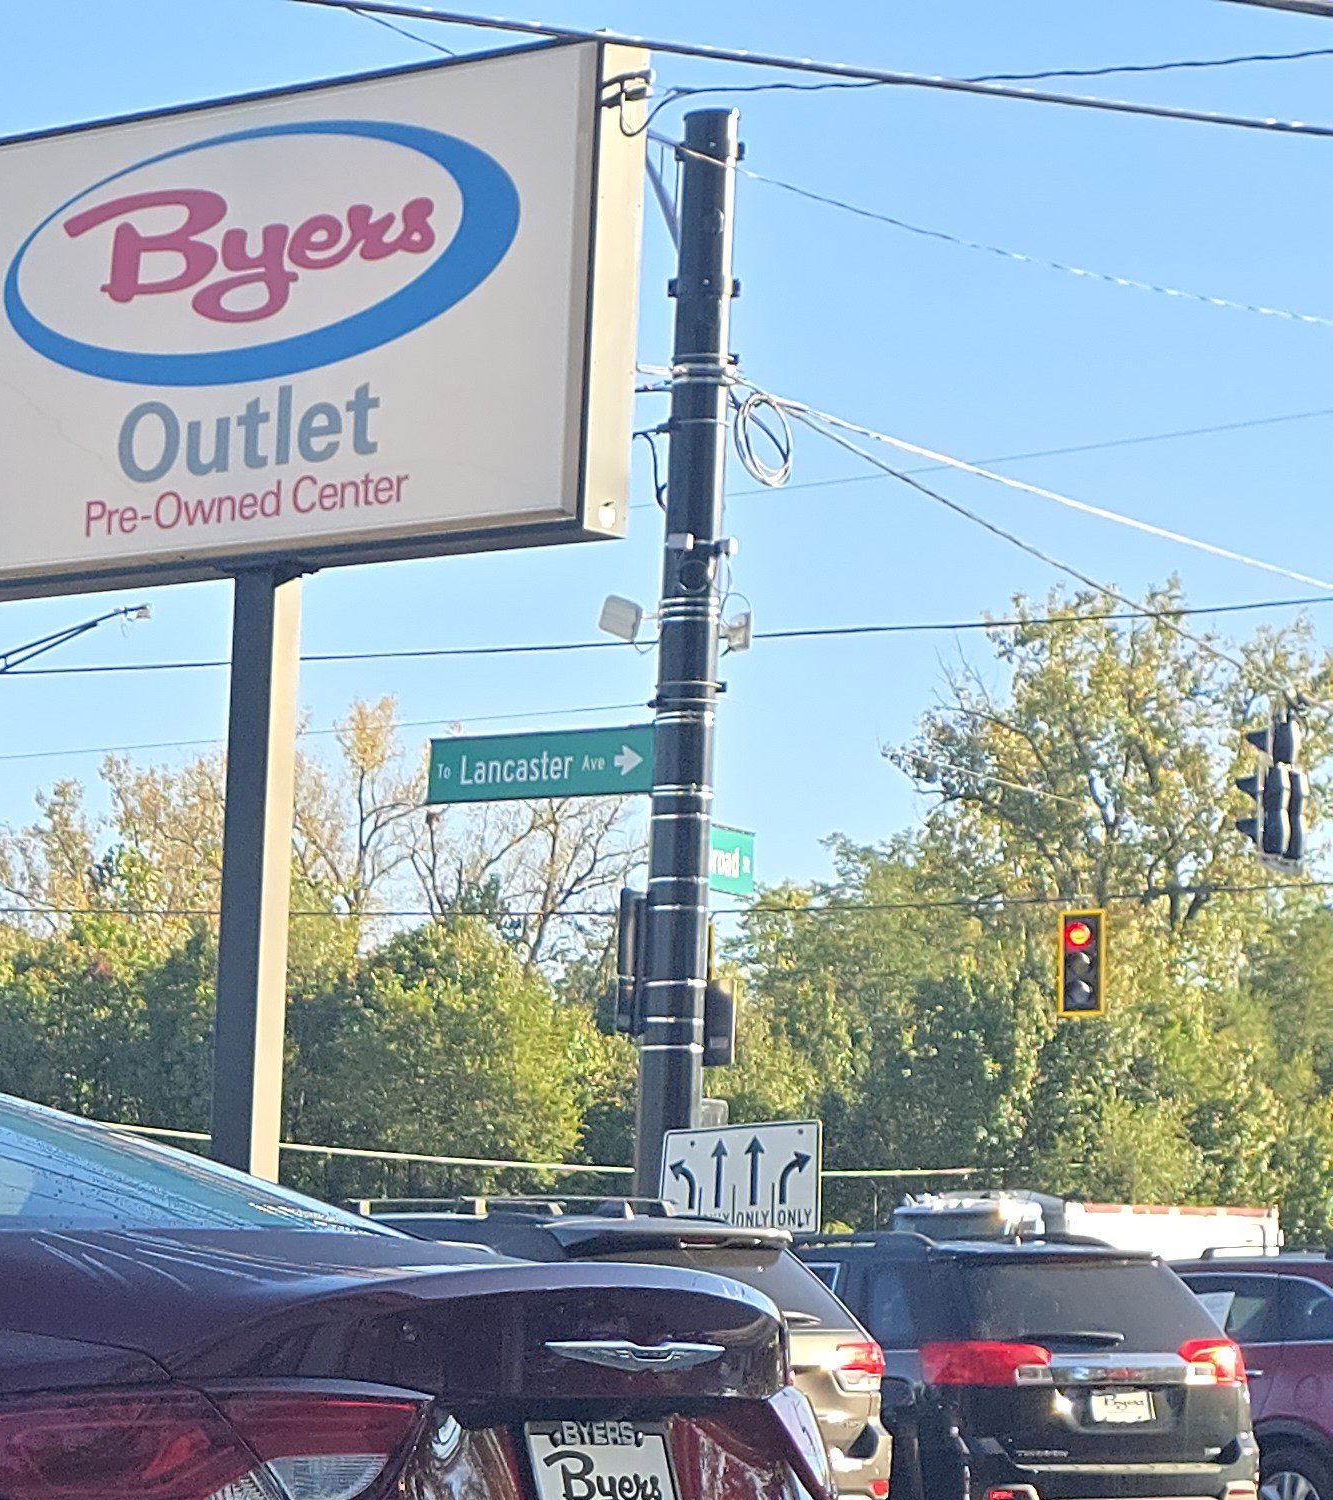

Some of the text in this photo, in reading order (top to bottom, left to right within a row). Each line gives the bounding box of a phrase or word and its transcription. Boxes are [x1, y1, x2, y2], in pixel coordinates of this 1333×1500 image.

[62, 188, 436, 324] Byers
[118, 383, 380, 484] Outlet
[84, 472, 409, 538] Pre-Owned Center
[437, 750, 606, 786] To Lancaster Ave
[710, 847, 740, 879] road
[736, 1210, 770, 1227] ONLY
[777, 1208, 812, 1227] ONLY
[561, 1421, 635, 1446] BYERS
